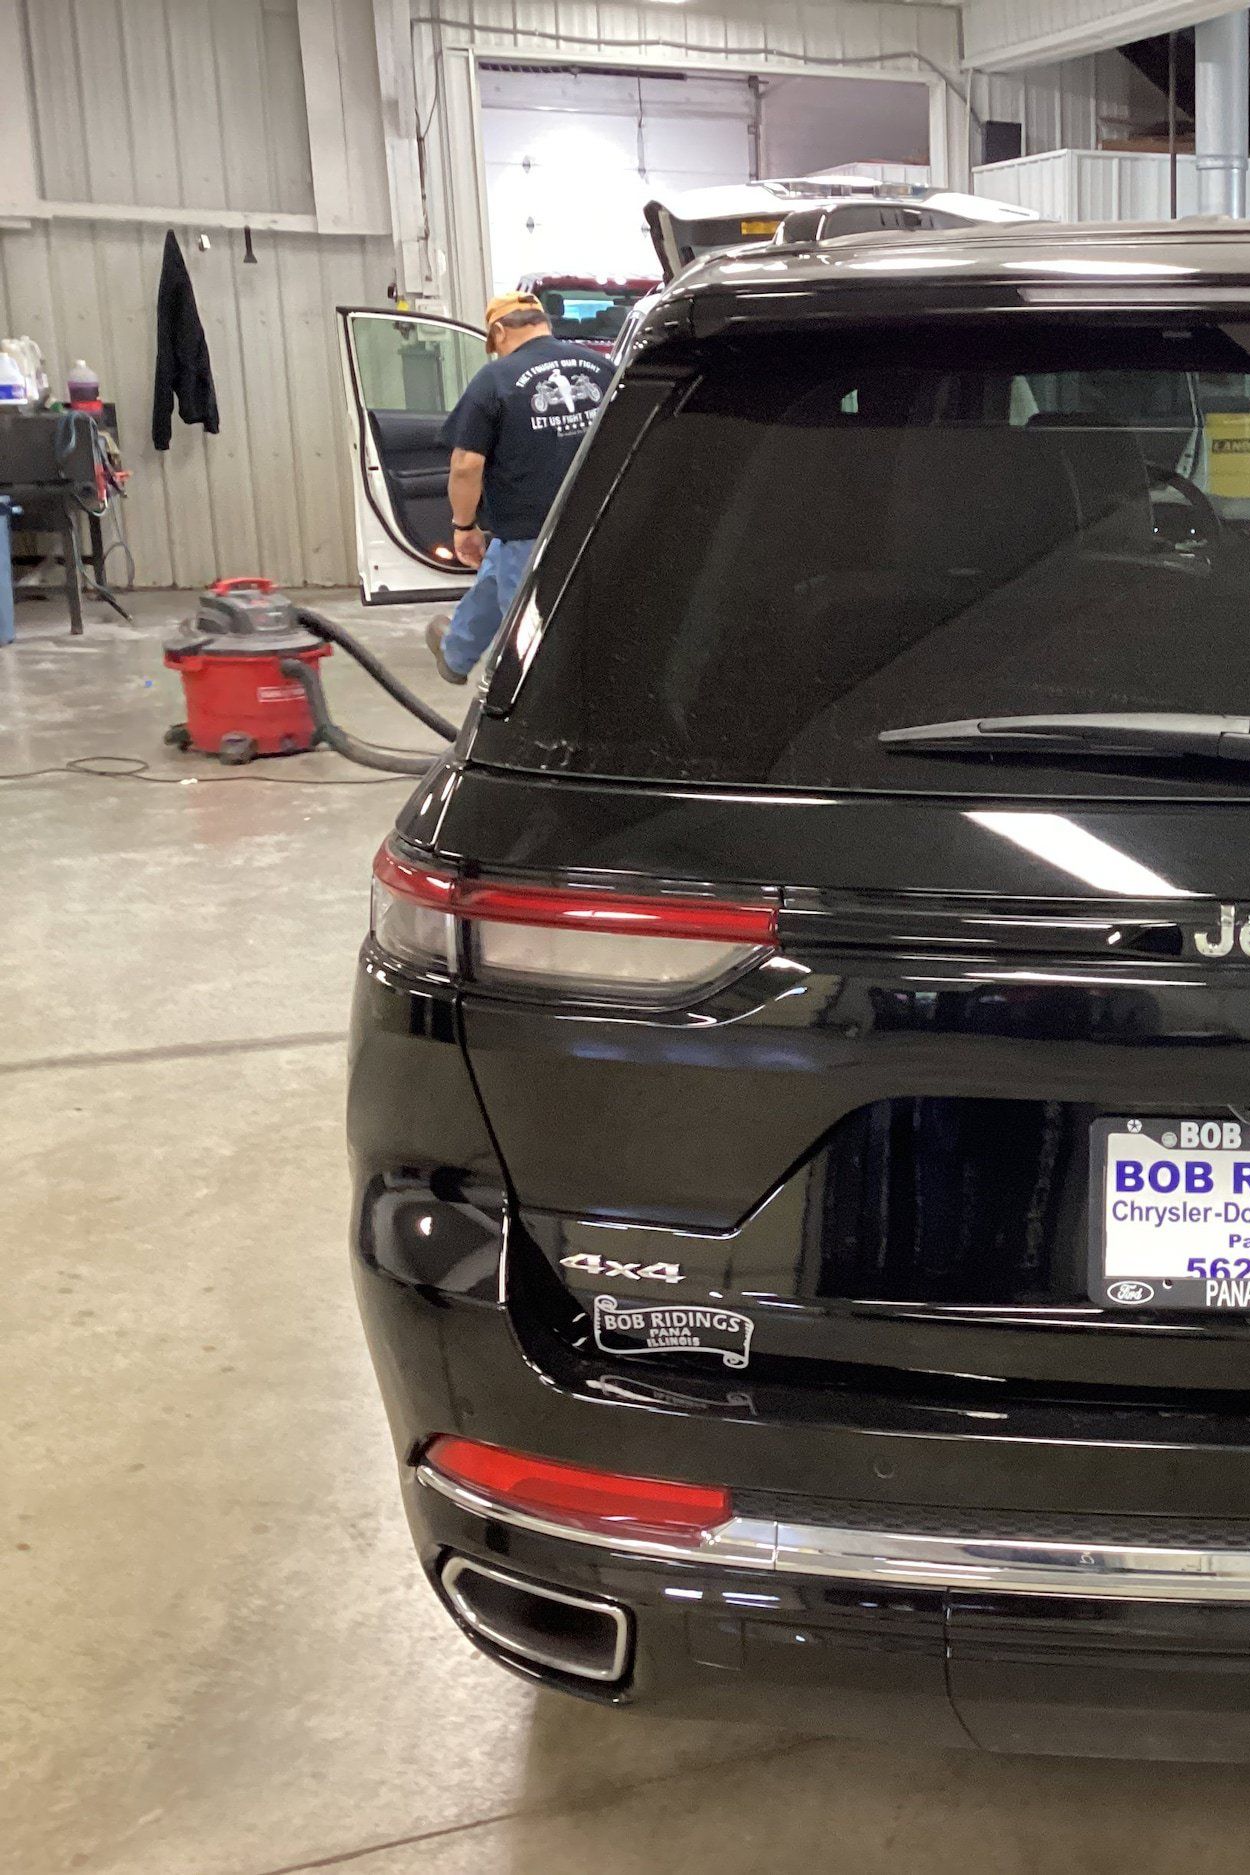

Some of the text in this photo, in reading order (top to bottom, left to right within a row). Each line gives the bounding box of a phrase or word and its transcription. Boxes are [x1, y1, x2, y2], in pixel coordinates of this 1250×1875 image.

[516, 359, 600, 388] THEY FOUGHT OUR FIGHT
[531, 416, 548, 430] LET
[549, 416, 561, 427] US
[562, 413, 583, 424] FIGHT
[1180, 1122, 1242, 1149] BOB
[1116, 1160, 1214, 1194] BOB
[604, 1312, 740, 1332] BOB RIDINGS
[650, 1327, 691, 1337] PANA
[647, 1337, 700, 1347] ILLINOIS
